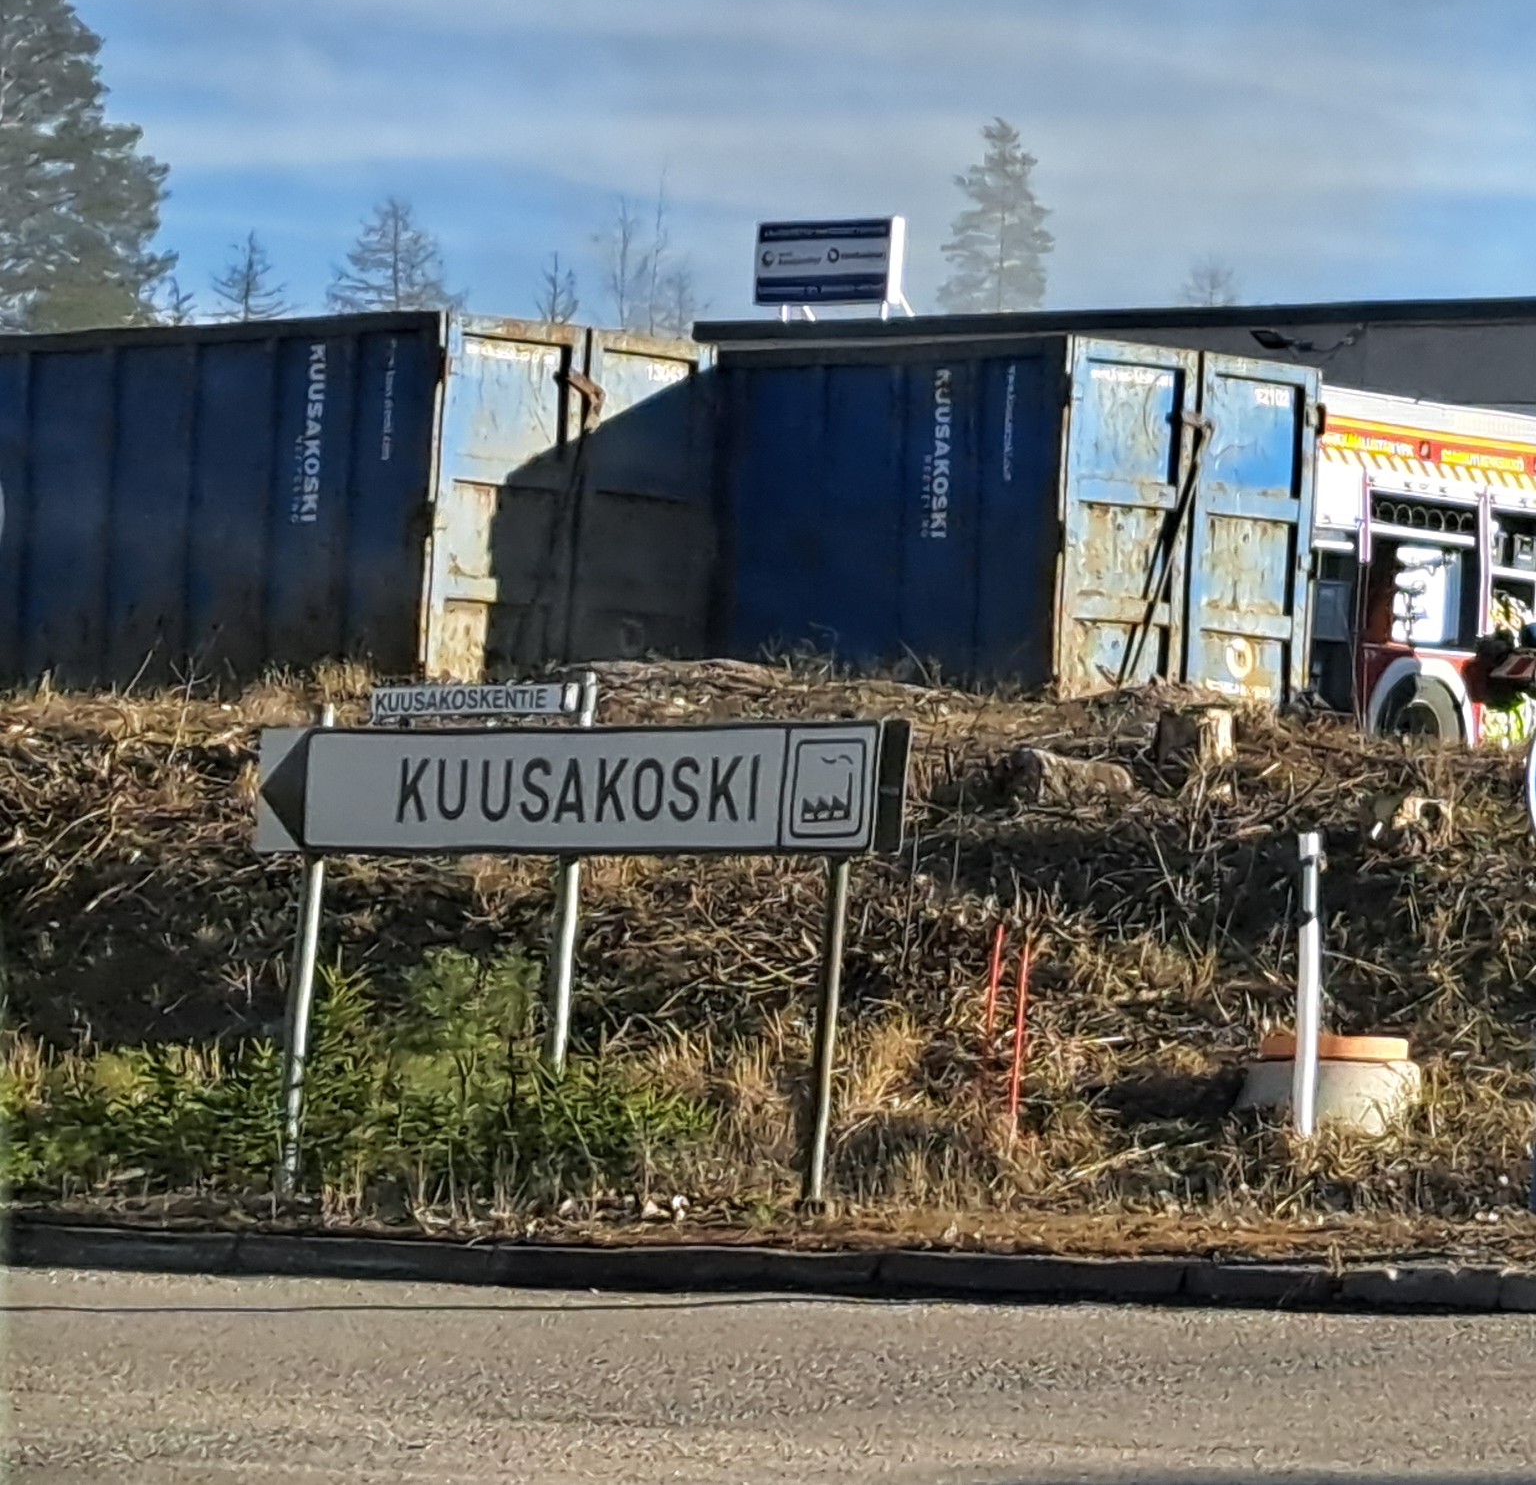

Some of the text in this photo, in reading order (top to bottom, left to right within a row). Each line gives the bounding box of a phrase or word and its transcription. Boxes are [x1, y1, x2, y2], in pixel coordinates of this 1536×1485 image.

[301, 343, 326, 522] KUUSAKOSKI
[930, 369, 951, 538] KUUSAKOSKI
[375, 688, 548, 713] KUUSAKOSKENTIE
[395, 754, 761, 825] KUUSAKOSKI
